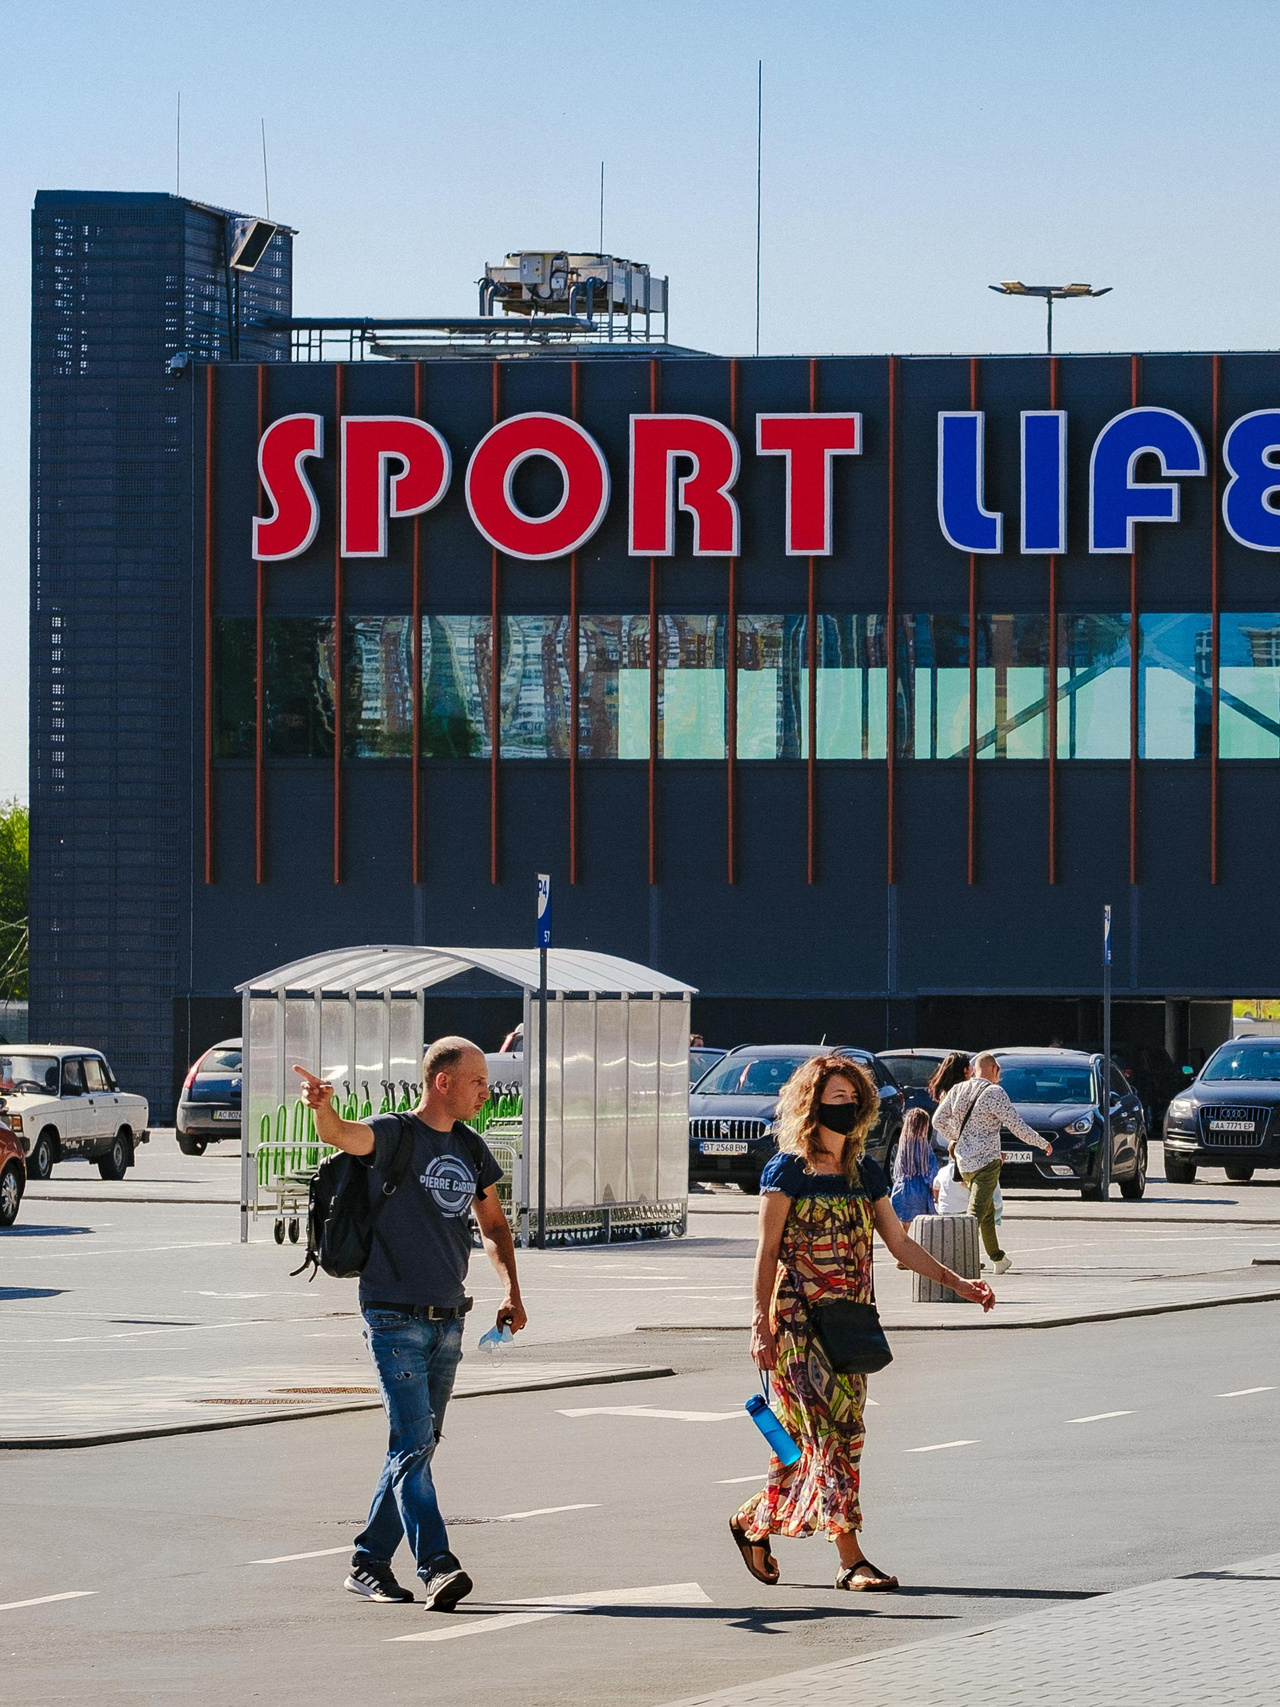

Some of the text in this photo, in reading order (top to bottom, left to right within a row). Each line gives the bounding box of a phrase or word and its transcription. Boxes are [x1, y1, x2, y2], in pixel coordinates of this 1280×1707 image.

[252, 411, 863, 561] SPORT
[1226, 1122, 1242, 1130] 7771
[1243, 1122, 1253, 1130] EP
[703, 1143, 746, 1152] BT 2568 BM
[1020, 1153, 1031, 1161] XA
[420, 1175, 451, 1190] PIERRE
